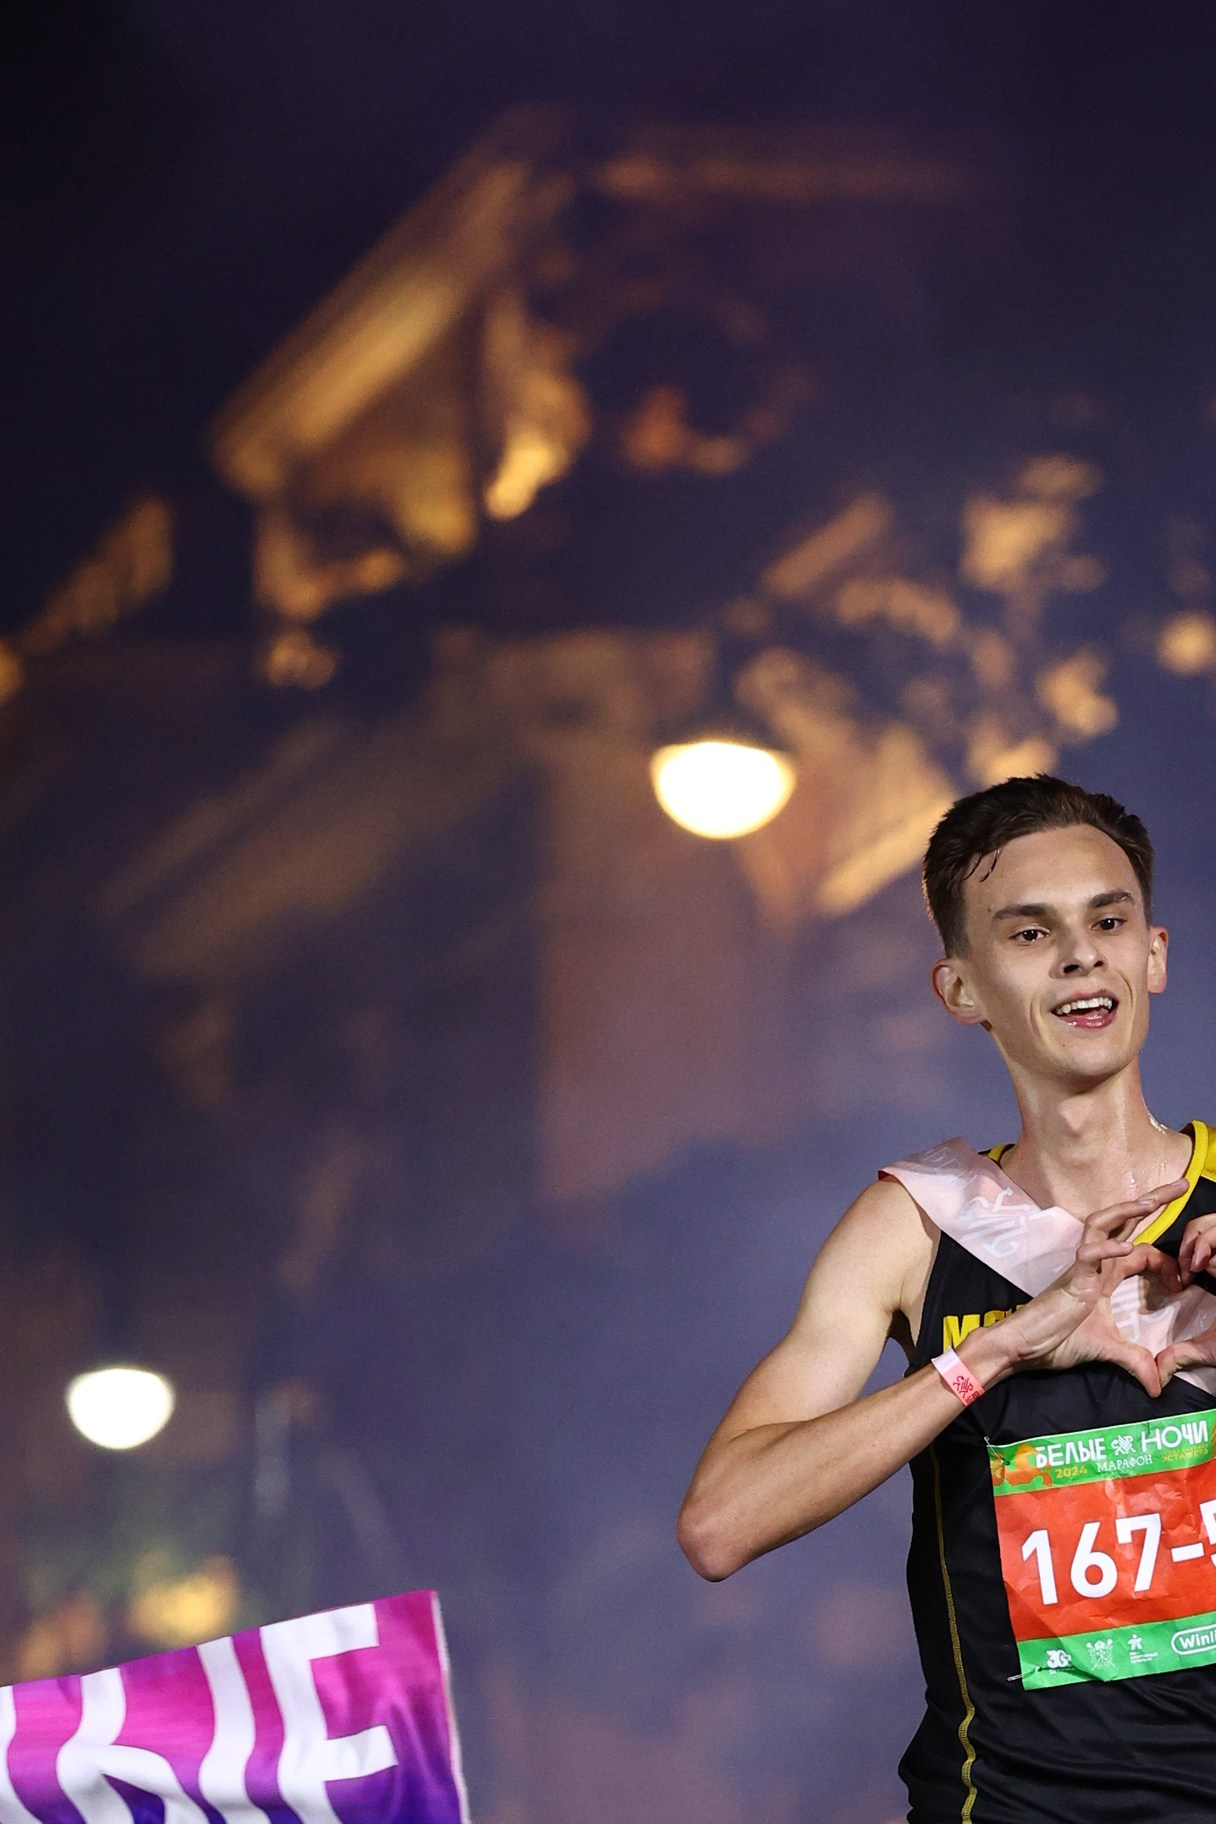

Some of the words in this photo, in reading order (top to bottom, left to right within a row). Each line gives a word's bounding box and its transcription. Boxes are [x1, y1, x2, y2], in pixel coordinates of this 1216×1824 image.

[1035, 1437, 1107, 1469] БЕЛЫЕ
[1141, 1420, 1209, 1452] НОЧИ
[1055, 1464, 1088, 1479] 2024
[1096, 1454, 1154, 1473] МАРАФОН
